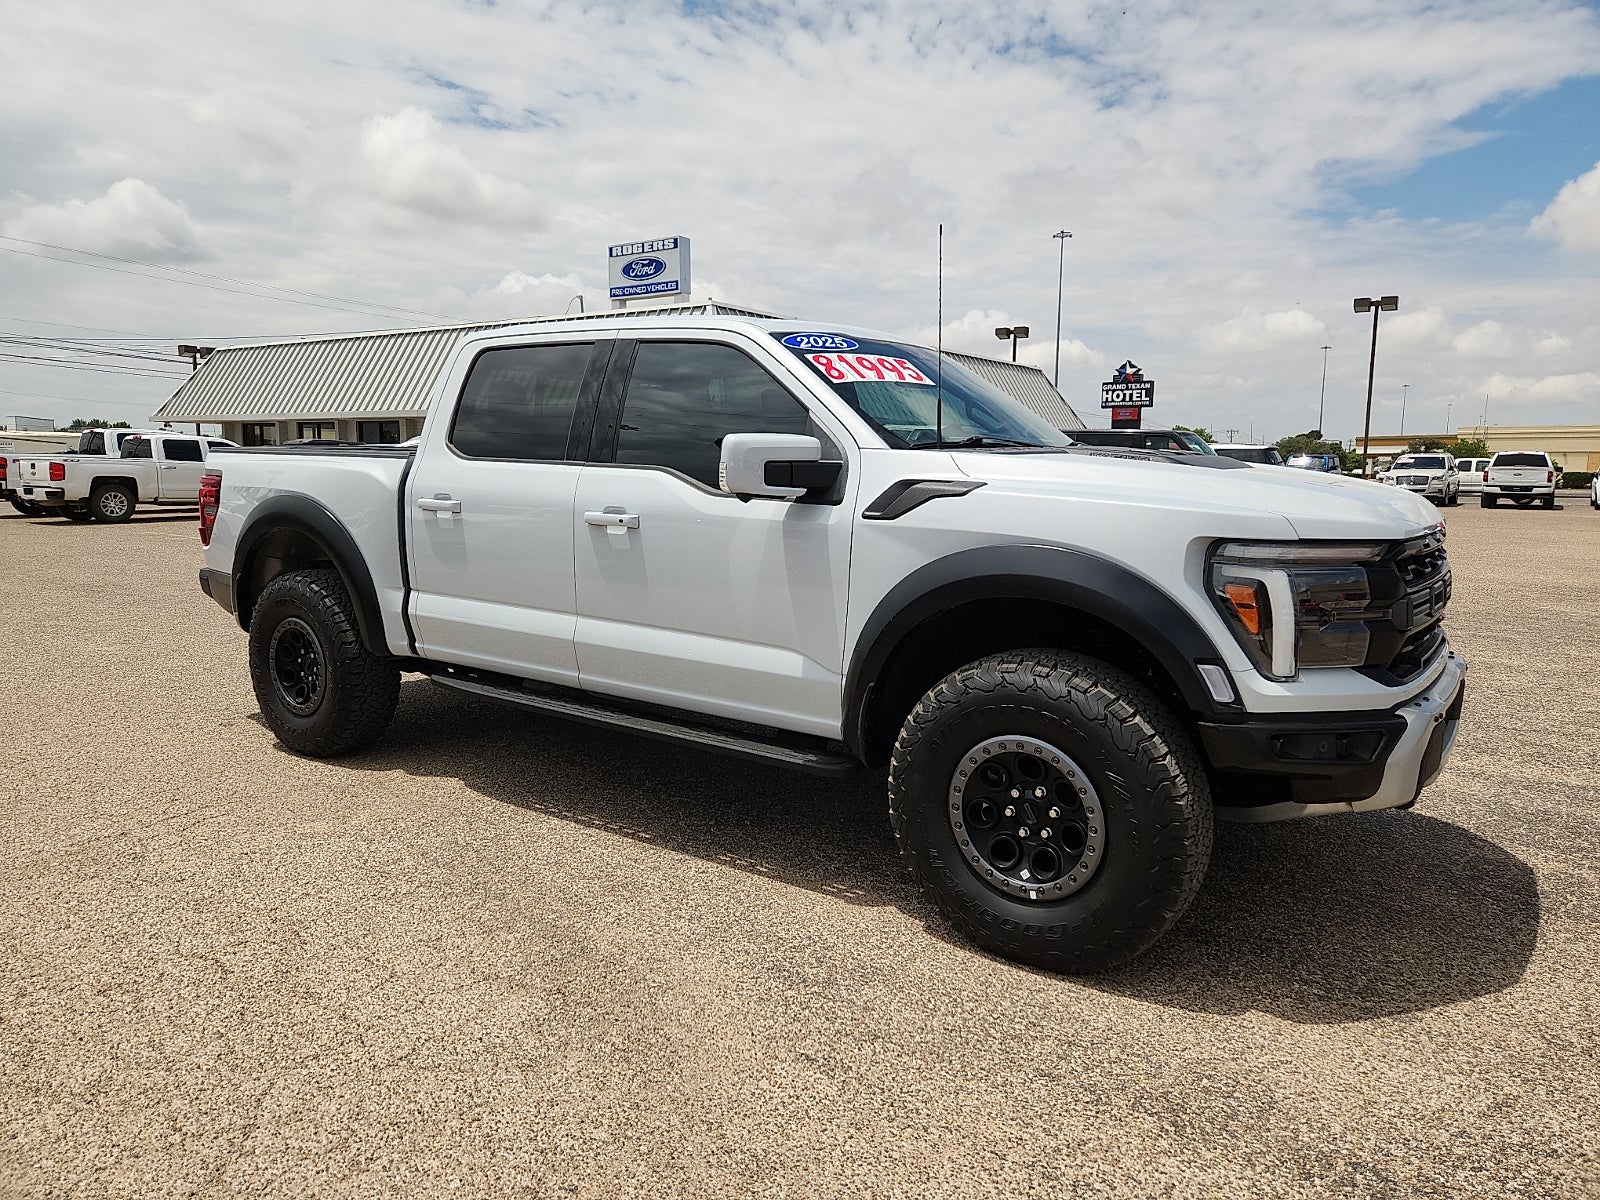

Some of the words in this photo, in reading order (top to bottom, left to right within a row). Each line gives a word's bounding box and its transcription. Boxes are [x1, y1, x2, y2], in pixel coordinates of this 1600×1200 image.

[612, 239, 675, 257] ROGERS
[629, 260, 656, 277] Ford
[611, 286, 647, 296] PRE-OWNED
[647, 282, 677, 293] VEHICLES
[797, 336, 848, 349] 2025
[812, 354, 925, 383] 81995
[1102, 390, 1150, 402] HOTEL
